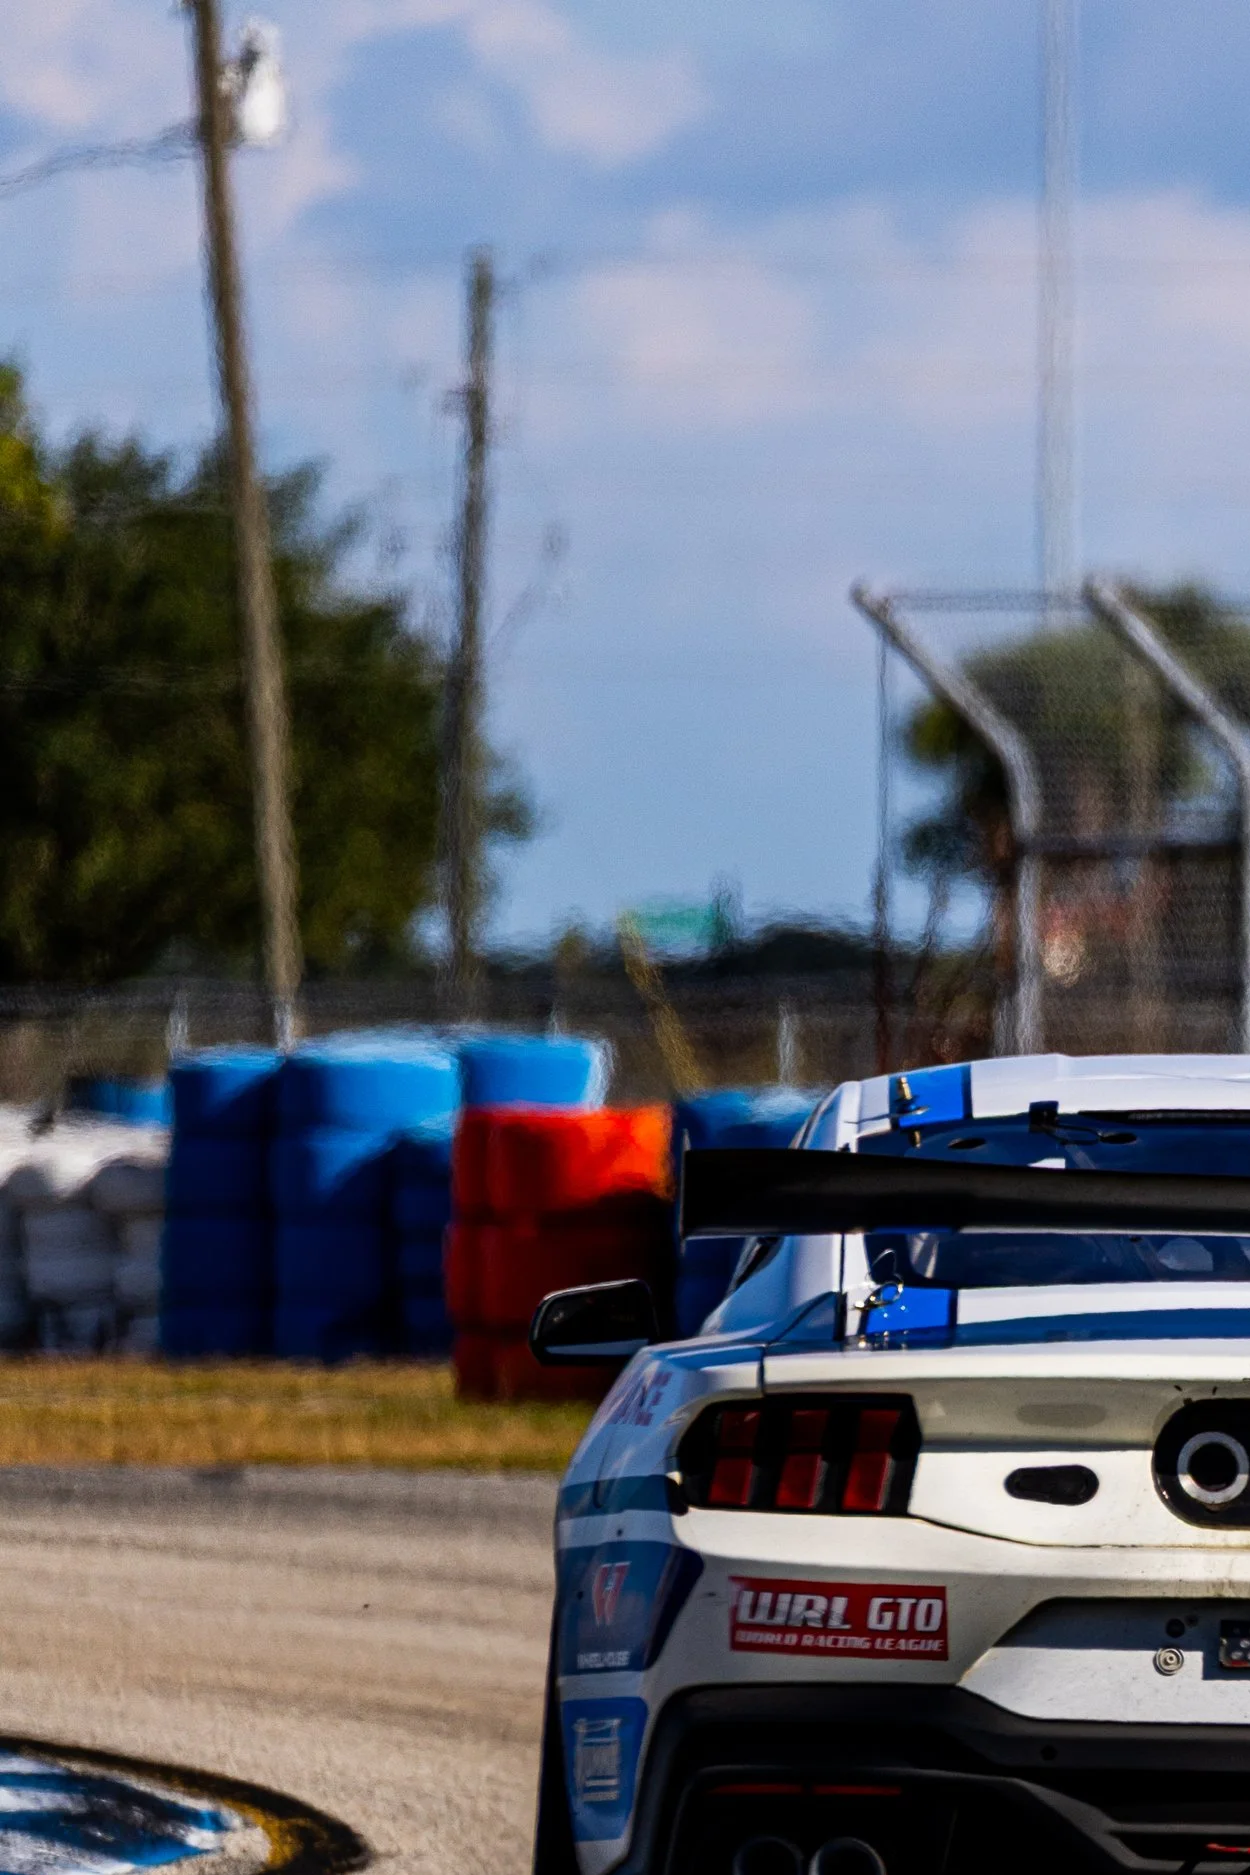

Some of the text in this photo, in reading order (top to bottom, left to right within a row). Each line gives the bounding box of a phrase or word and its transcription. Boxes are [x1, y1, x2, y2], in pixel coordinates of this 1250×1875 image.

[735, 1590, 852, 1629] WRL
[734, 1629, 945, 1651] WORLD RACING LEAGUE
